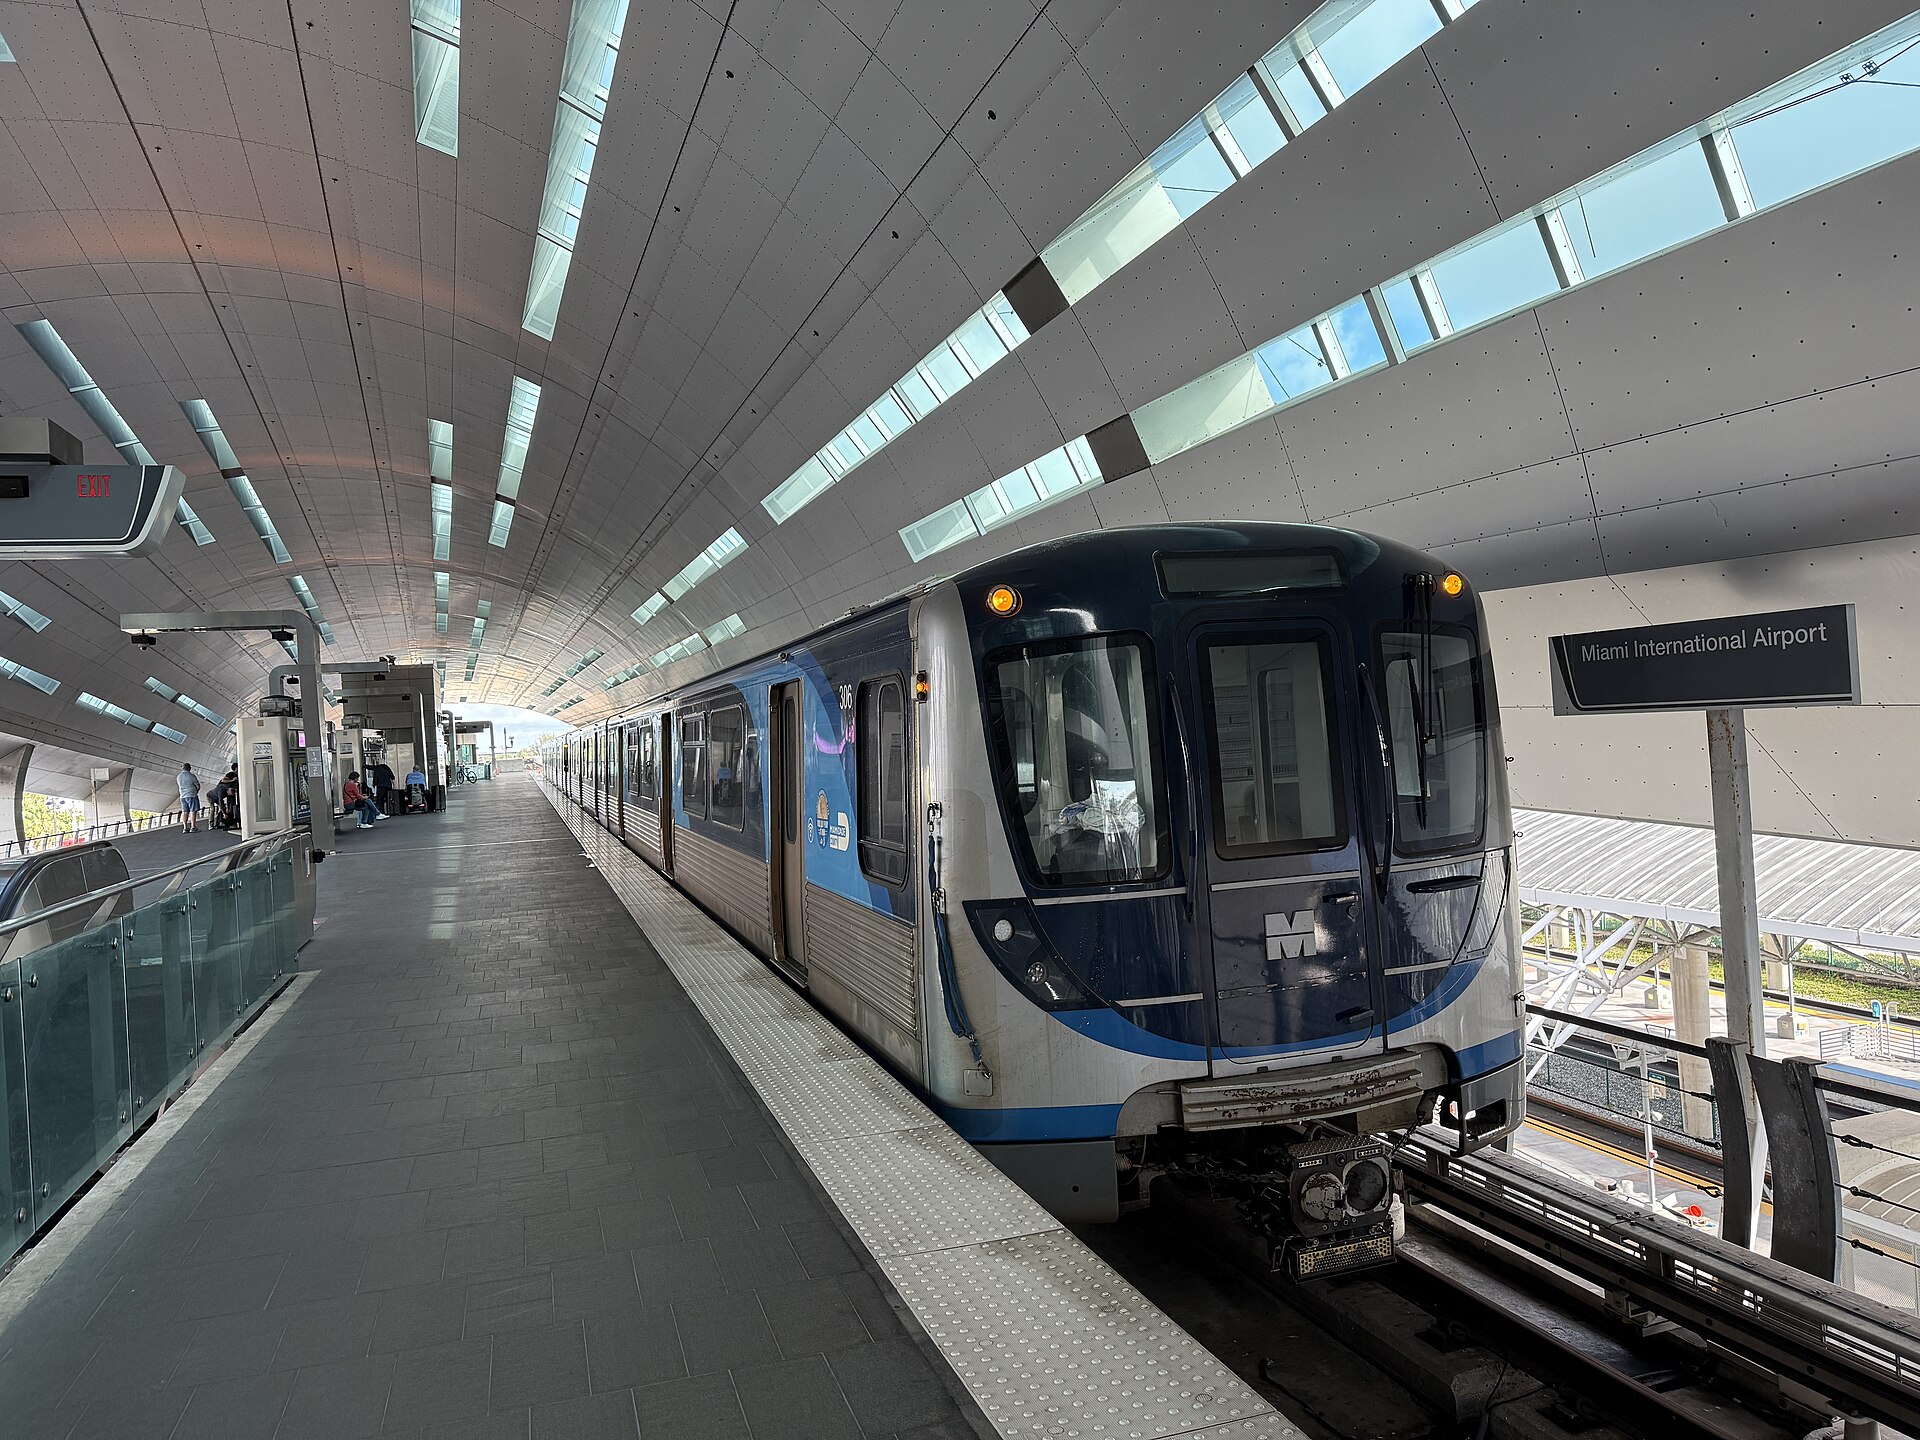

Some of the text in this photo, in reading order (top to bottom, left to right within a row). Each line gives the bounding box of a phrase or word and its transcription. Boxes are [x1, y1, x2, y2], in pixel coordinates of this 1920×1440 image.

[78, 475, 112, 498] EXIT
[1581, 622, 1828, 662] Miami International Airport
[839, 684, 852, 709] 306
